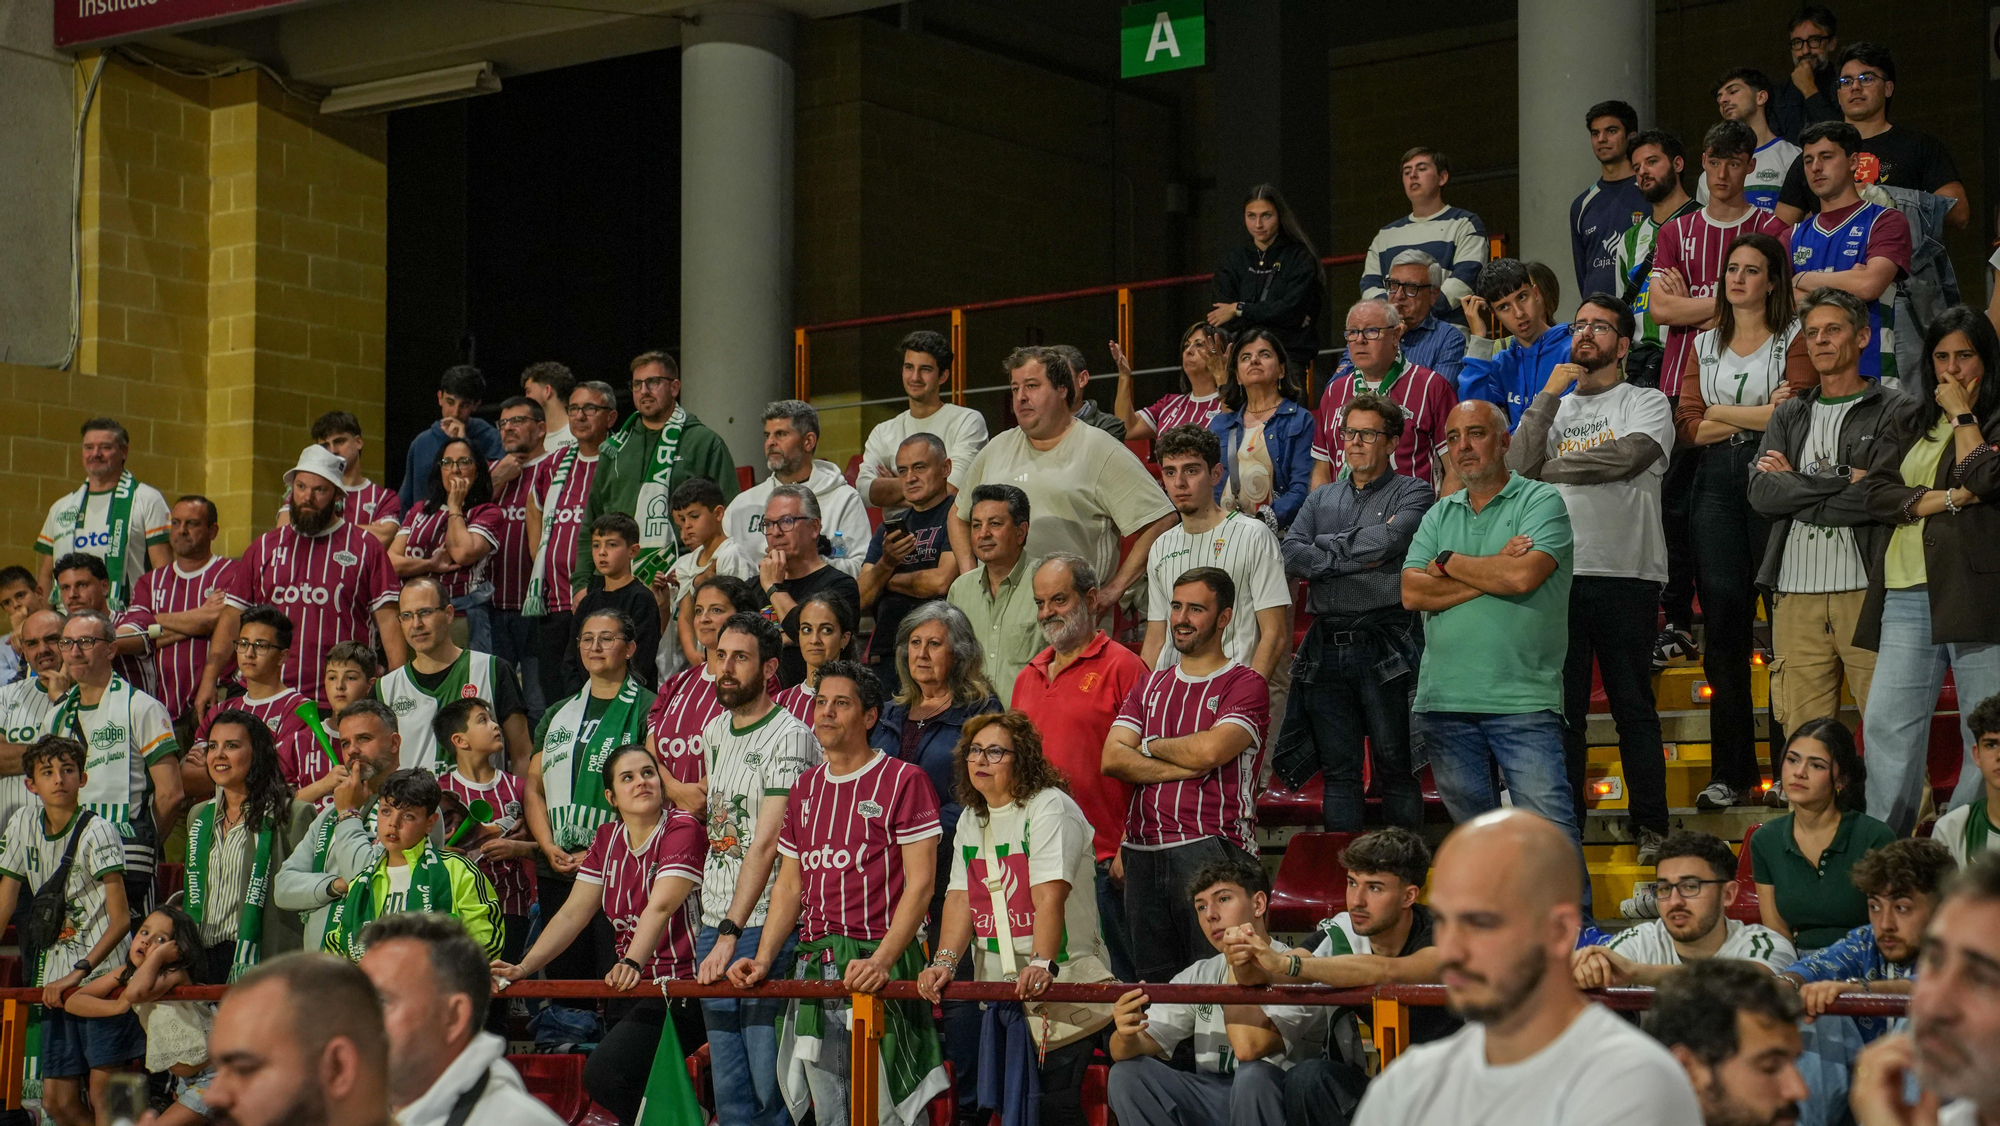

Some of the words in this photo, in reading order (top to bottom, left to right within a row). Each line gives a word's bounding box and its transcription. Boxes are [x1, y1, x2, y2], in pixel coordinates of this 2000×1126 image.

[1145, 11, 1181, 62] A
[1680, 237, 1697, 261] 14
[1592, 257, 1611, 269] Caja
[1689, 281, 1719, 298] cot
[1734, 372, 1749, 404] 7
[1563, 416, 1608, 438] CORDOBA
[1557, 428, 1615, 456] PRIMERA
[501, 505, 526, 521] oto
[554, 505, 584, 524] cot
[75, 531, 110, 548] oto
[271, 547, 288, 566] 14
[405, 546, 430, 559] co
[152, 589, 166, 611] 14
[271, 583, 329, 605] coto
[8, 723, 42, 743] co
[658, 734, 703, 758] coto
[305, 750, 320, 774] 14
[588, 754, 598, 772] POR
[26, 845, 39, 873] 14
[801, 844, 851, 871] coto
[254, 876, 264, 887] EL
[248, 887, 261, 905] POR
[332, 904, 345, 923] POR
[612, 914, 640, 932] oto
